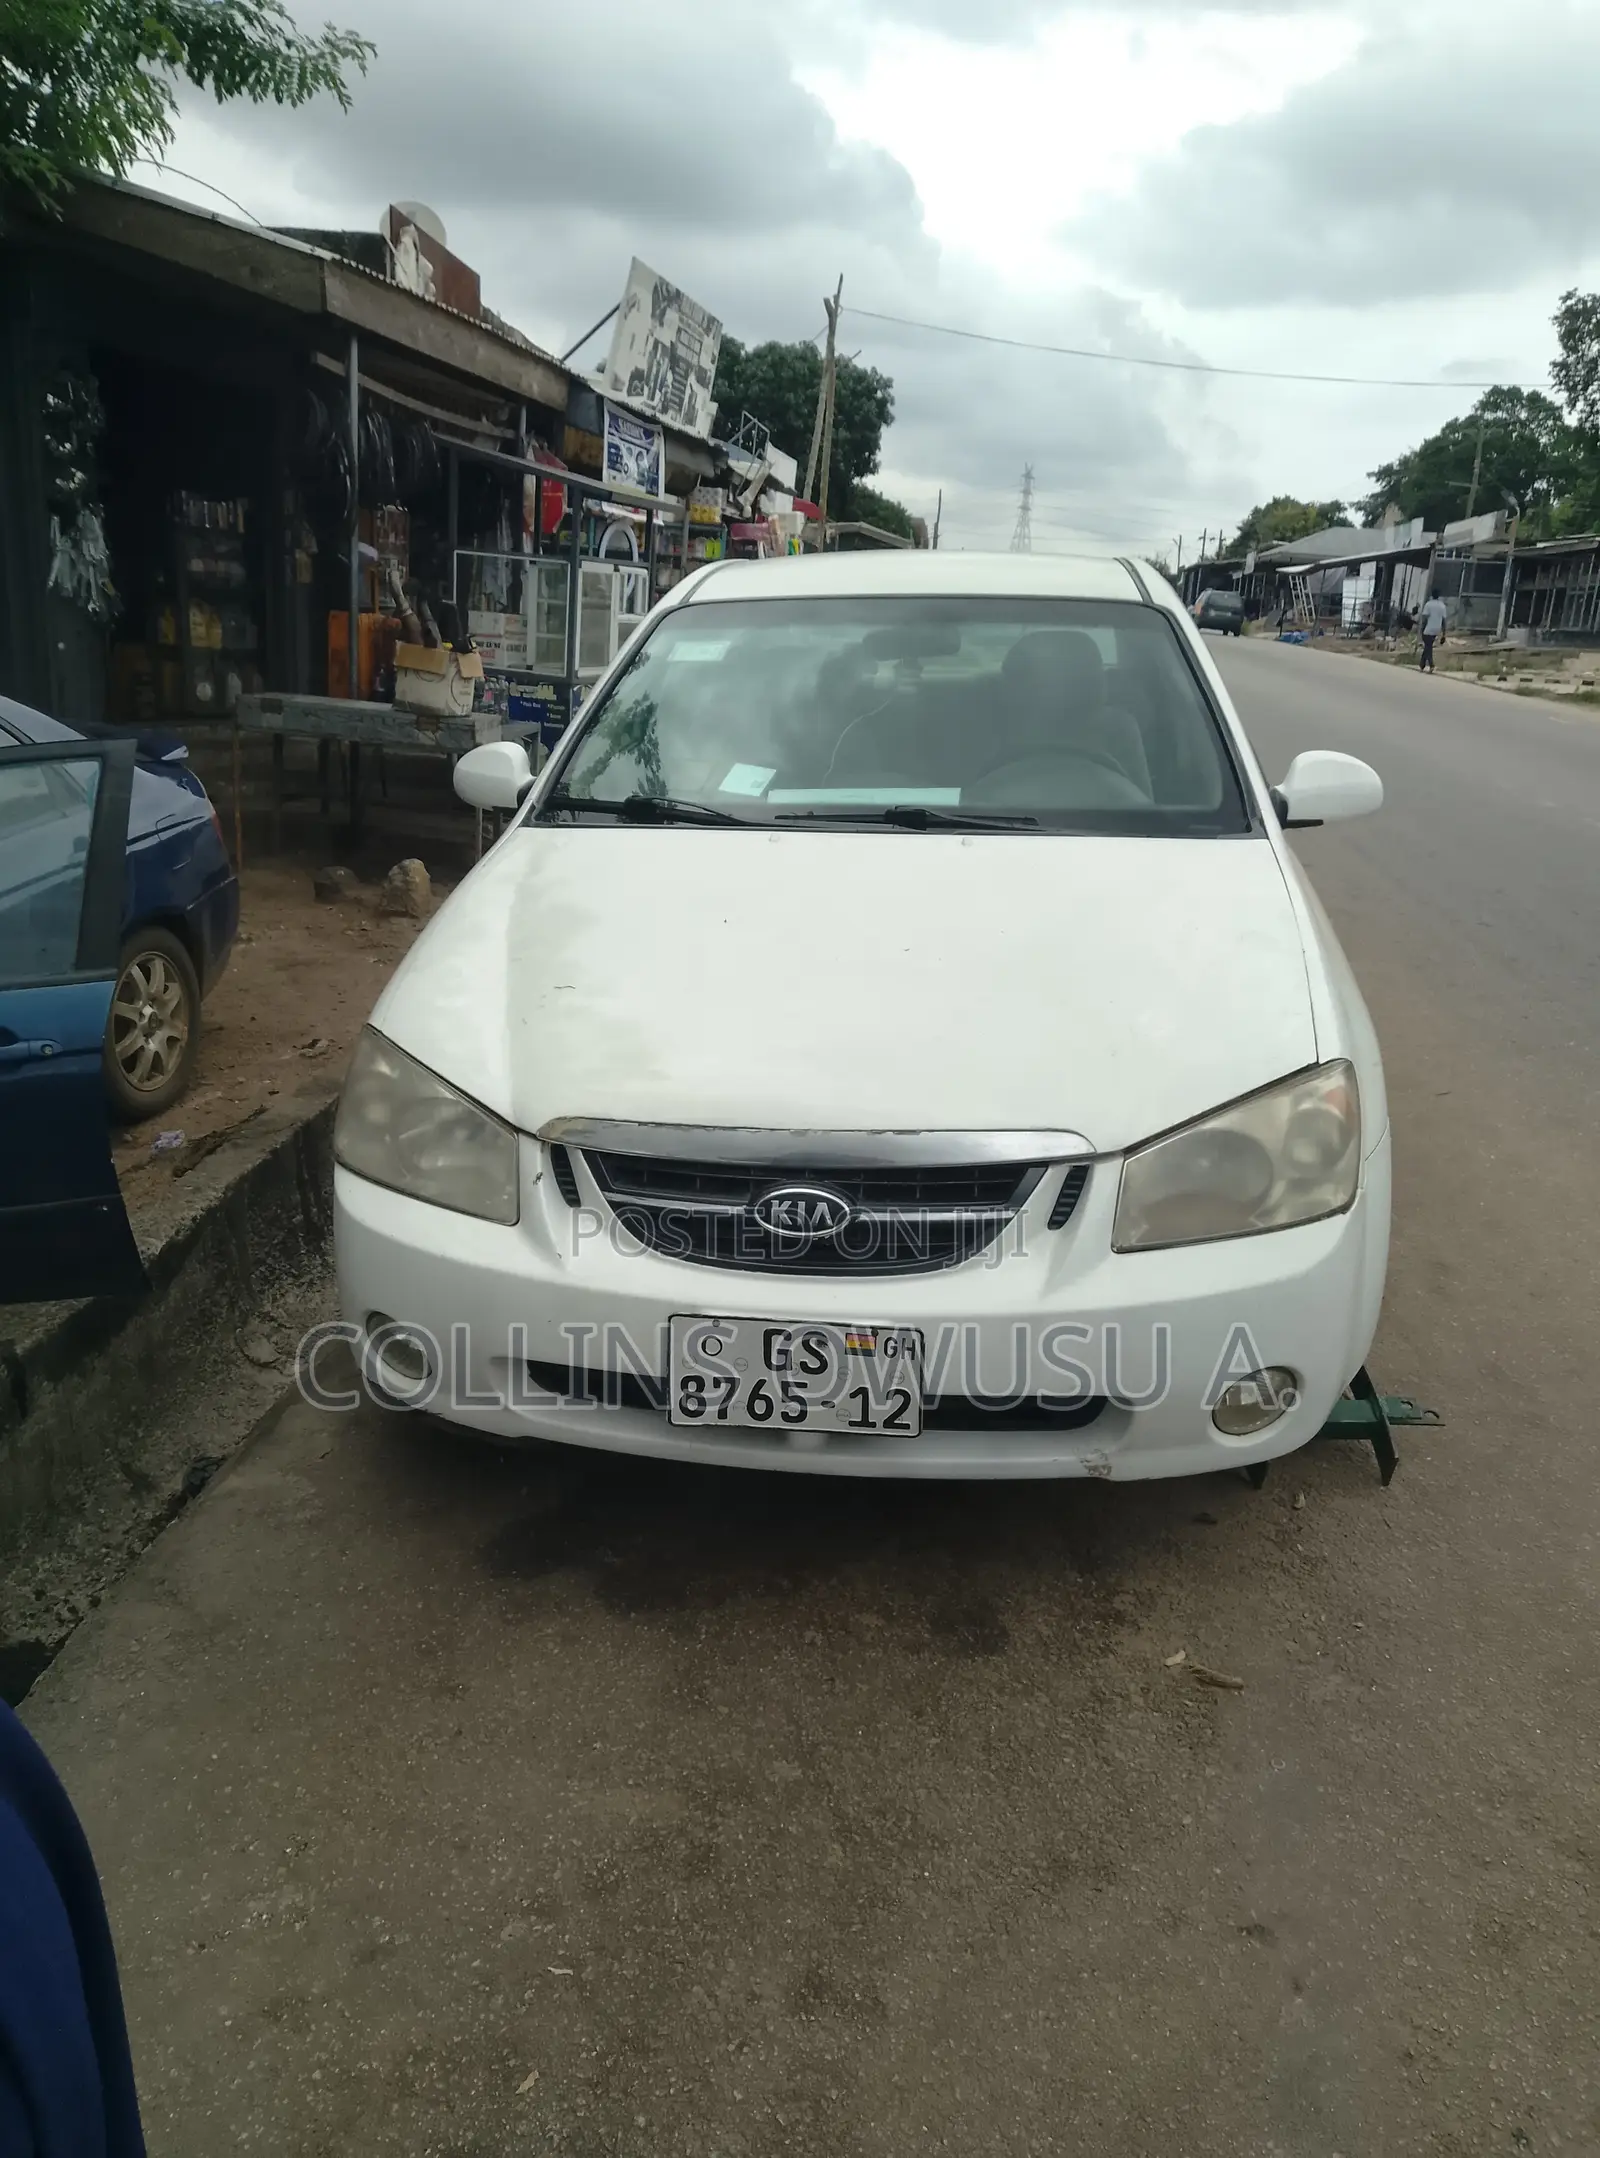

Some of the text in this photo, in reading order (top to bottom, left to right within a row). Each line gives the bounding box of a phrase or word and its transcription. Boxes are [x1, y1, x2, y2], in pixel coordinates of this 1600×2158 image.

[771, 1199, 834, 1227] KIA
[763, 1328, 916, 1375] GS GH
